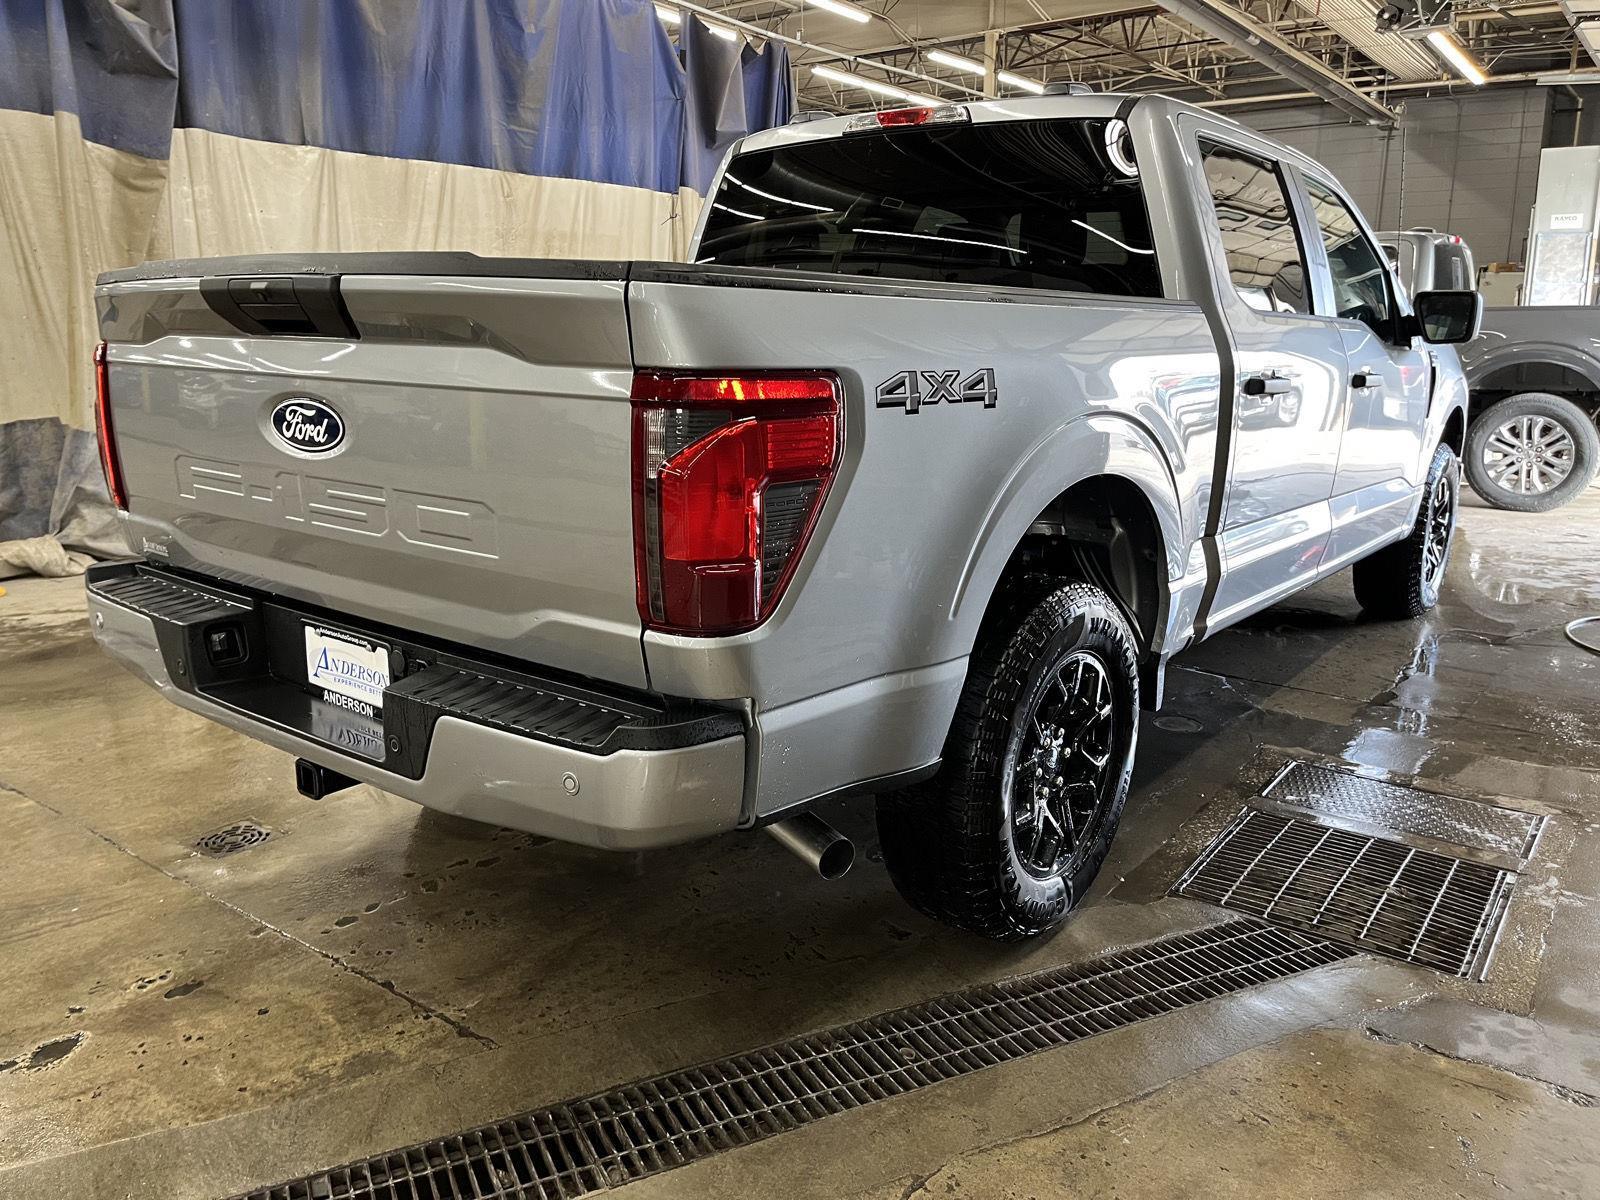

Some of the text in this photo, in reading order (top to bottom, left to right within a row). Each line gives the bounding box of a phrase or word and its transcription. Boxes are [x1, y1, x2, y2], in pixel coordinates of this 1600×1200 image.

[282, 405, 329, 444] Ford
[174, 454, 500, 560] F-150
[313, 646, 389, 688] ANDERSON
[333, 677, 367, 692] EXPERIENCE
[323, 690, 374, 717] ANDERSON
